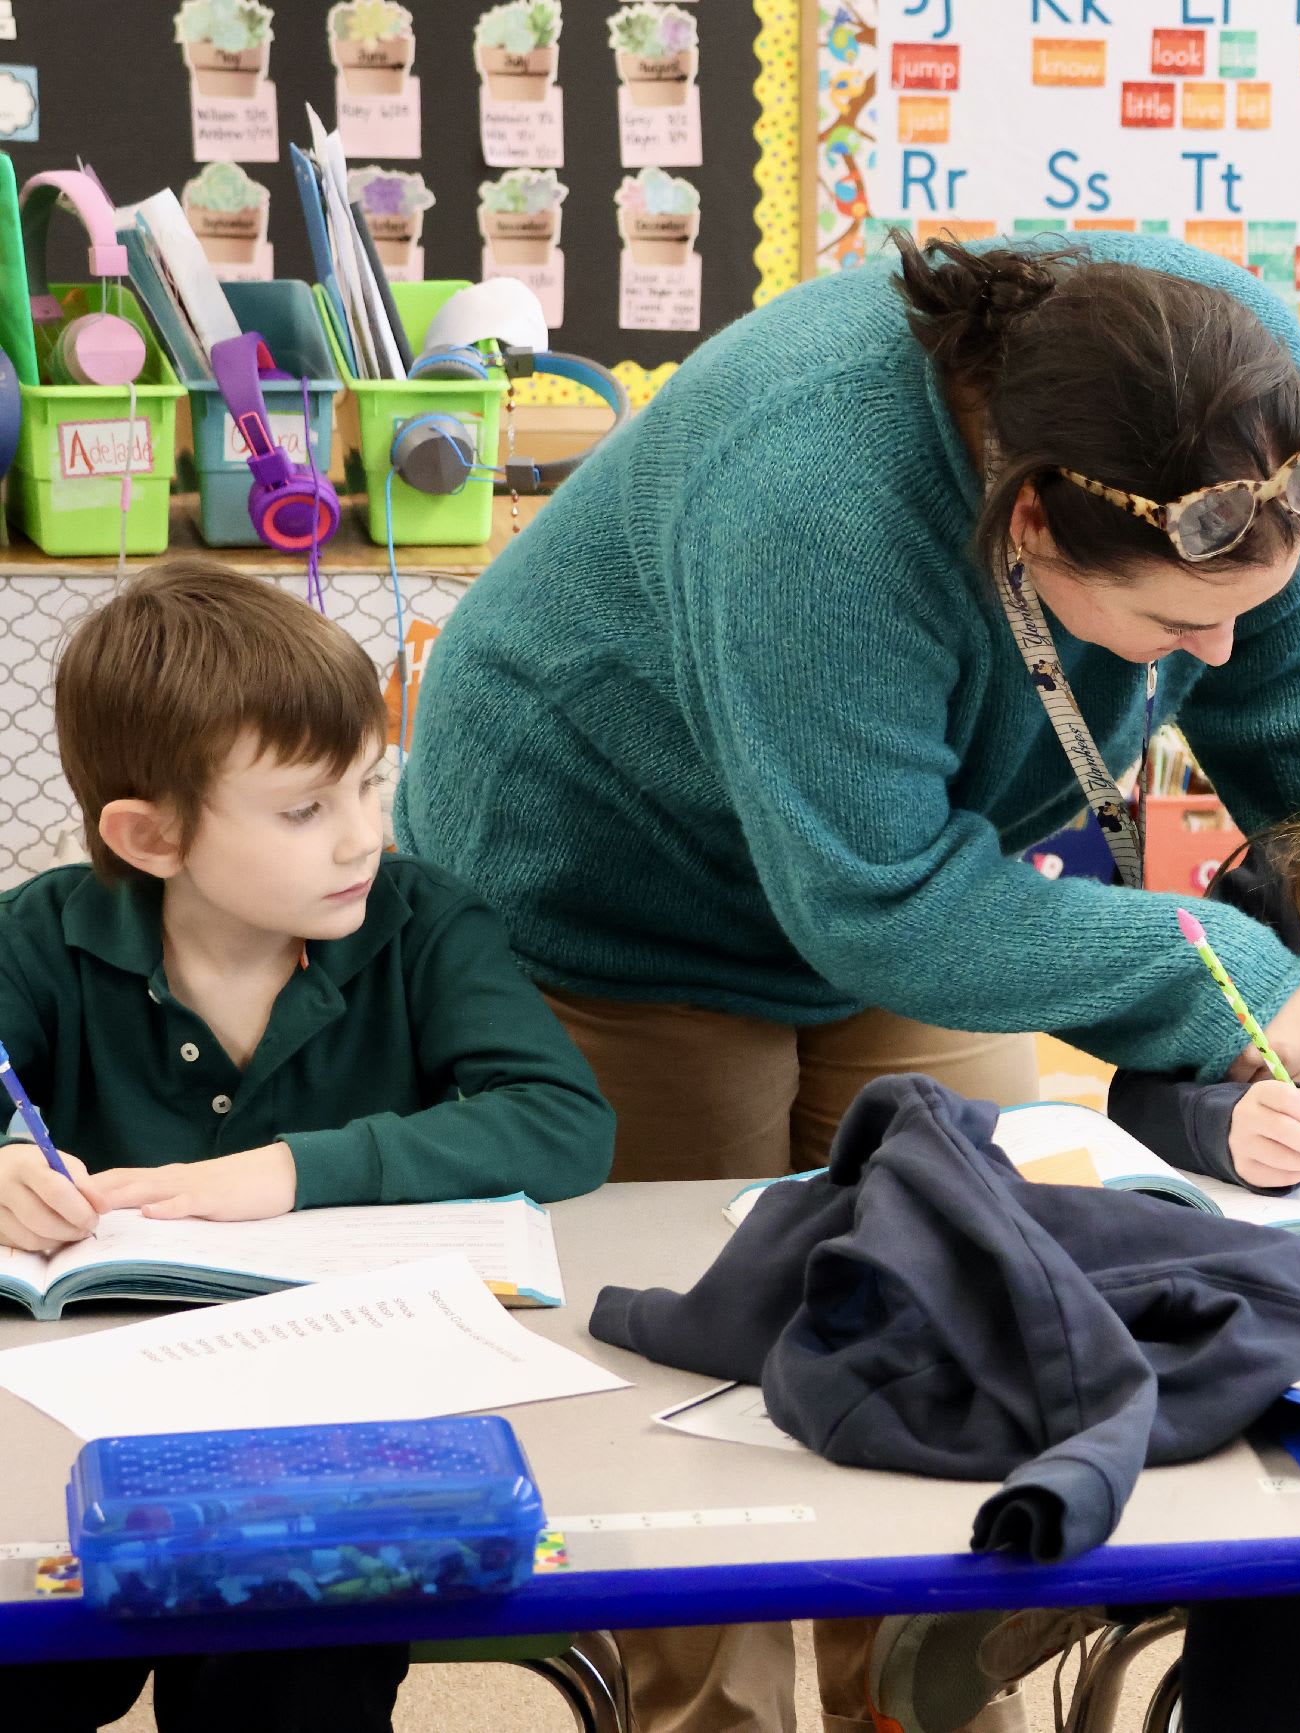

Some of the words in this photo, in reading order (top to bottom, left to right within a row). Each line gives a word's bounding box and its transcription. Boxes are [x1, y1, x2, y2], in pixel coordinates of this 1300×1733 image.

[640, 59, 681, 77] August
[1040, 51, 1101, 77] know
[1154, 39, 1202, 67] look
[897, 55, 955, 89] jump
[1125, 92, 1171, 119] little
[902, 150, 967, 210] Rr
[1046, 150, 1110, 211] Ss
[1182, 152, 1242, 212] Tt
[69, 430, 153, 475] Adelade
